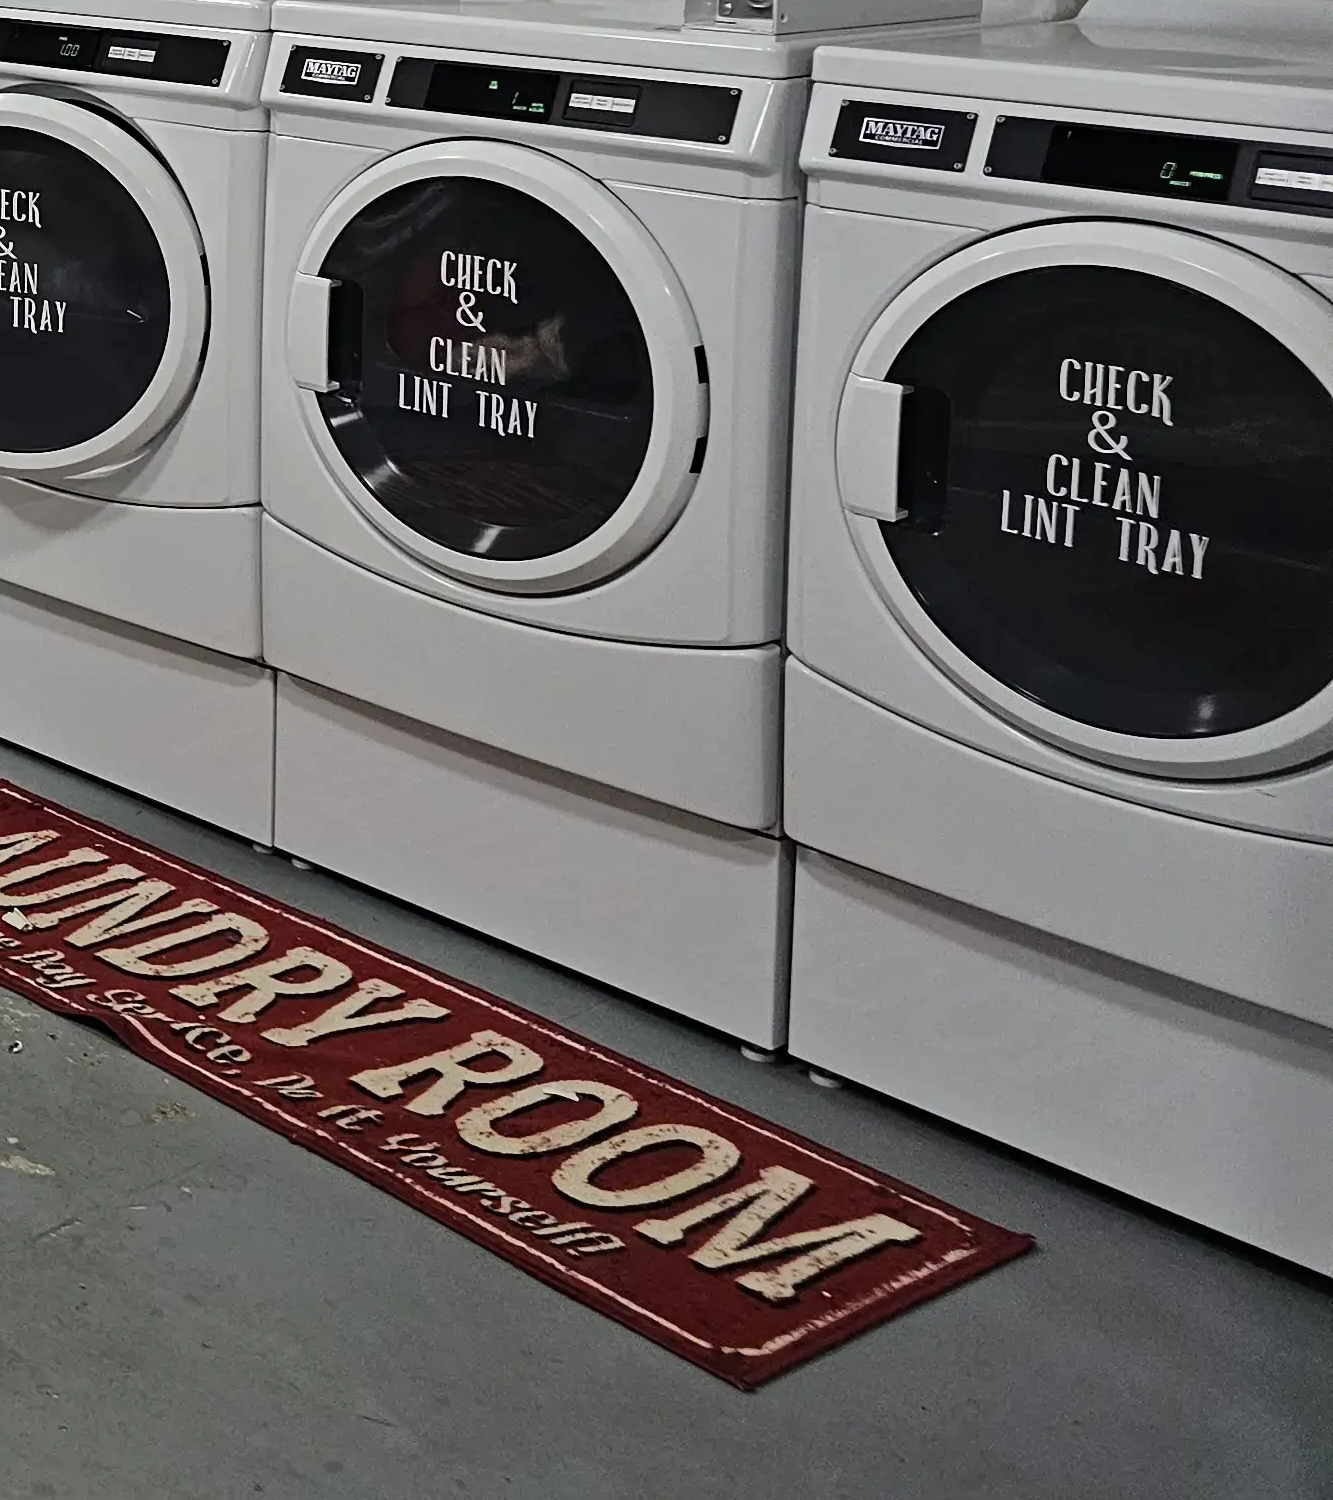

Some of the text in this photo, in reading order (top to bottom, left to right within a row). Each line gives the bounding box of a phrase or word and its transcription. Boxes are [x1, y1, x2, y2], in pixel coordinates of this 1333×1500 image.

[60, 43, 80, 56] 1.00
[306, 61, 357, 77] MAYTAG
[865, 121, 939, 141] MAYTAG
[440, 250, 519, 304] CHECK
[9, 296, 67, 334] TRAY
[455, 291, 487, 333] &
[429, 336, 506, 386] CLEAN
[398, 373, 538, 438] LINT TRAY
[1059, 358, 1174, 427] CHECK
[1087, 410, 1133, 461] &
[1046, 453, 1161, 519] CLEAN
[1000, 489, 1210, 580] LINT TRAY
[8, 947, 98, 989] Day
[350, 1030, 923, 1301] ROOM
